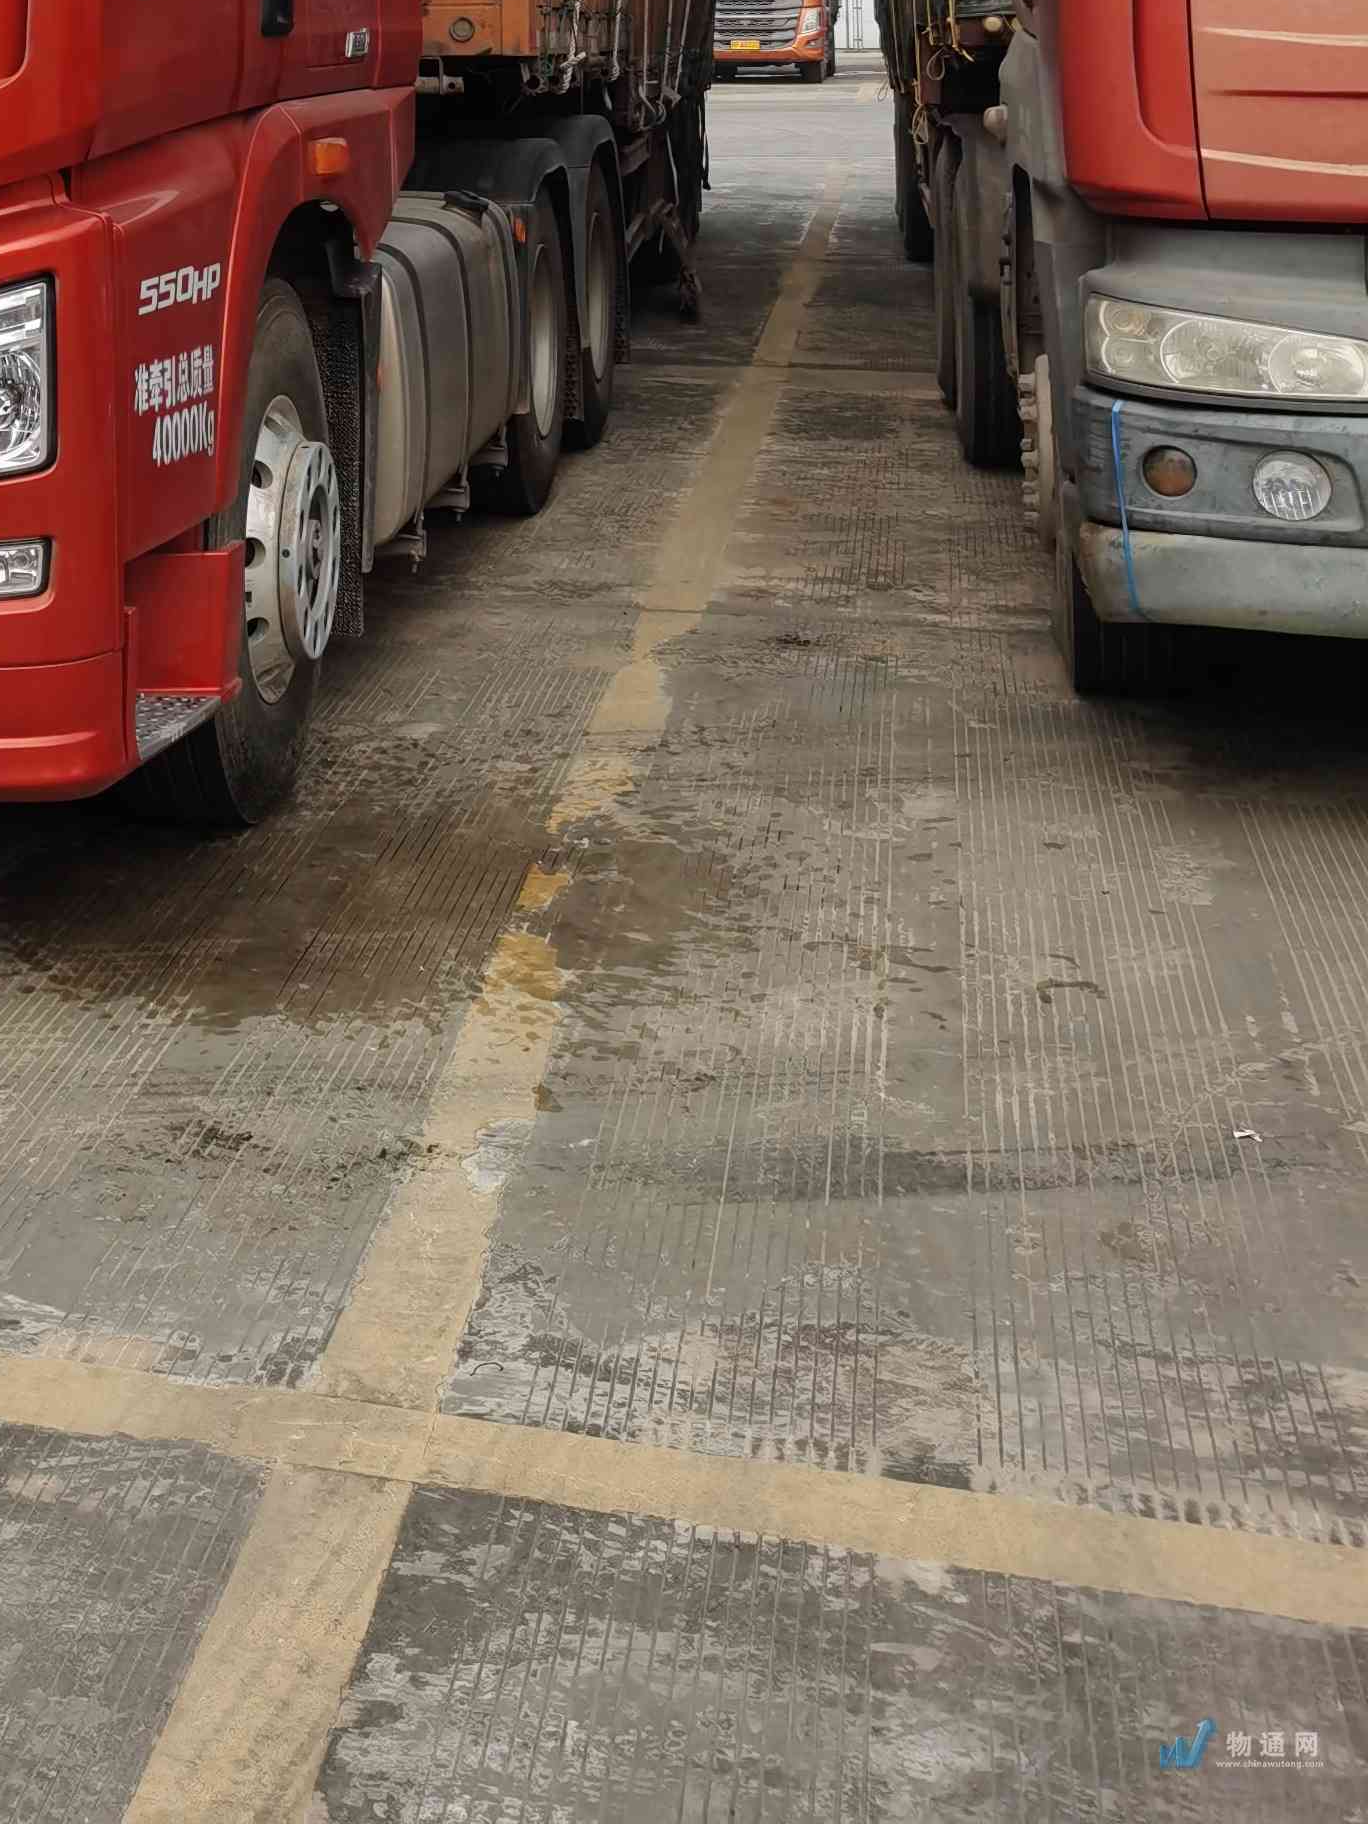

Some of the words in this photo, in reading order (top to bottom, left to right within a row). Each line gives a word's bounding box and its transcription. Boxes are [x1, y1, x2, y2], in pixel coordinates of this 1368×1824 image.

[138, 262, 221, 316] 550HP
[134, 343, 215, 417] 准牵引总质量
